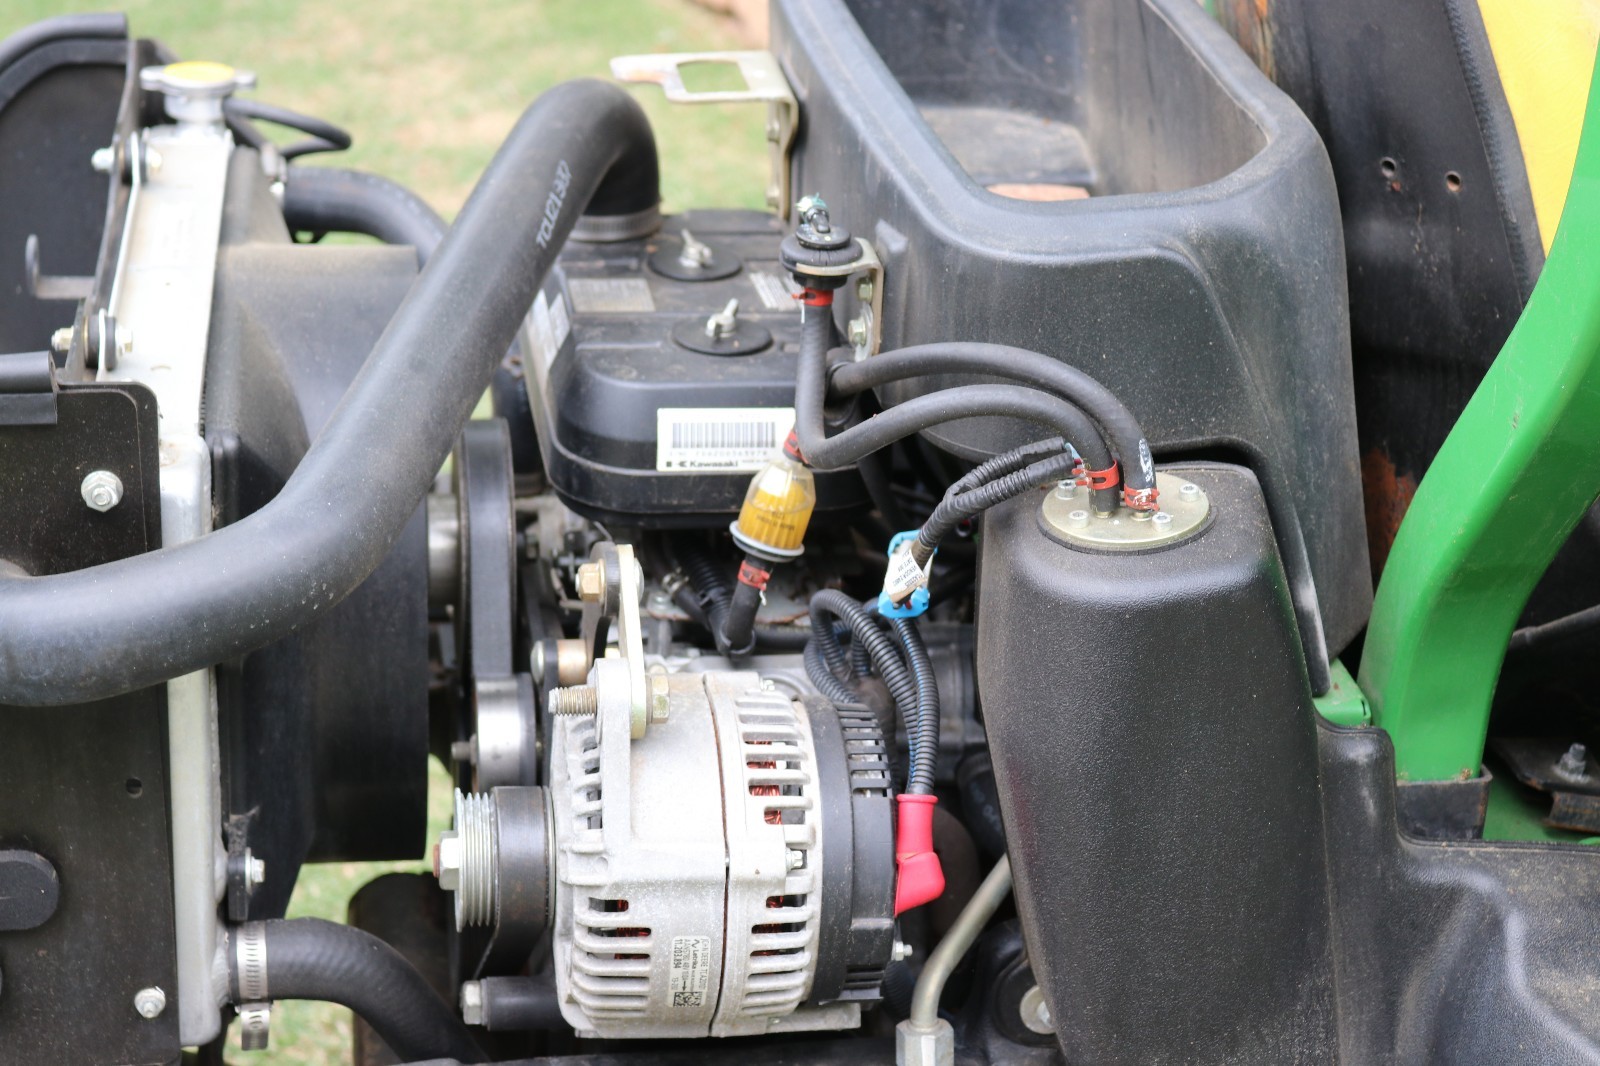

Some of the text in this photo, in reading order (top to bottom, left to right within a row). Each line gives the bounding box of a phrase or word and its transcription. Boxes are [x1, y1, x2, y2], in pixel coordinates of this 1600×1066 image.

[689, 460, 738, 468] Kawasaki
[673, 939, 683, 969] 11.203.894
[691, 949, 699, 969] Letrika
[700, 952, 709, 968] DEERE
